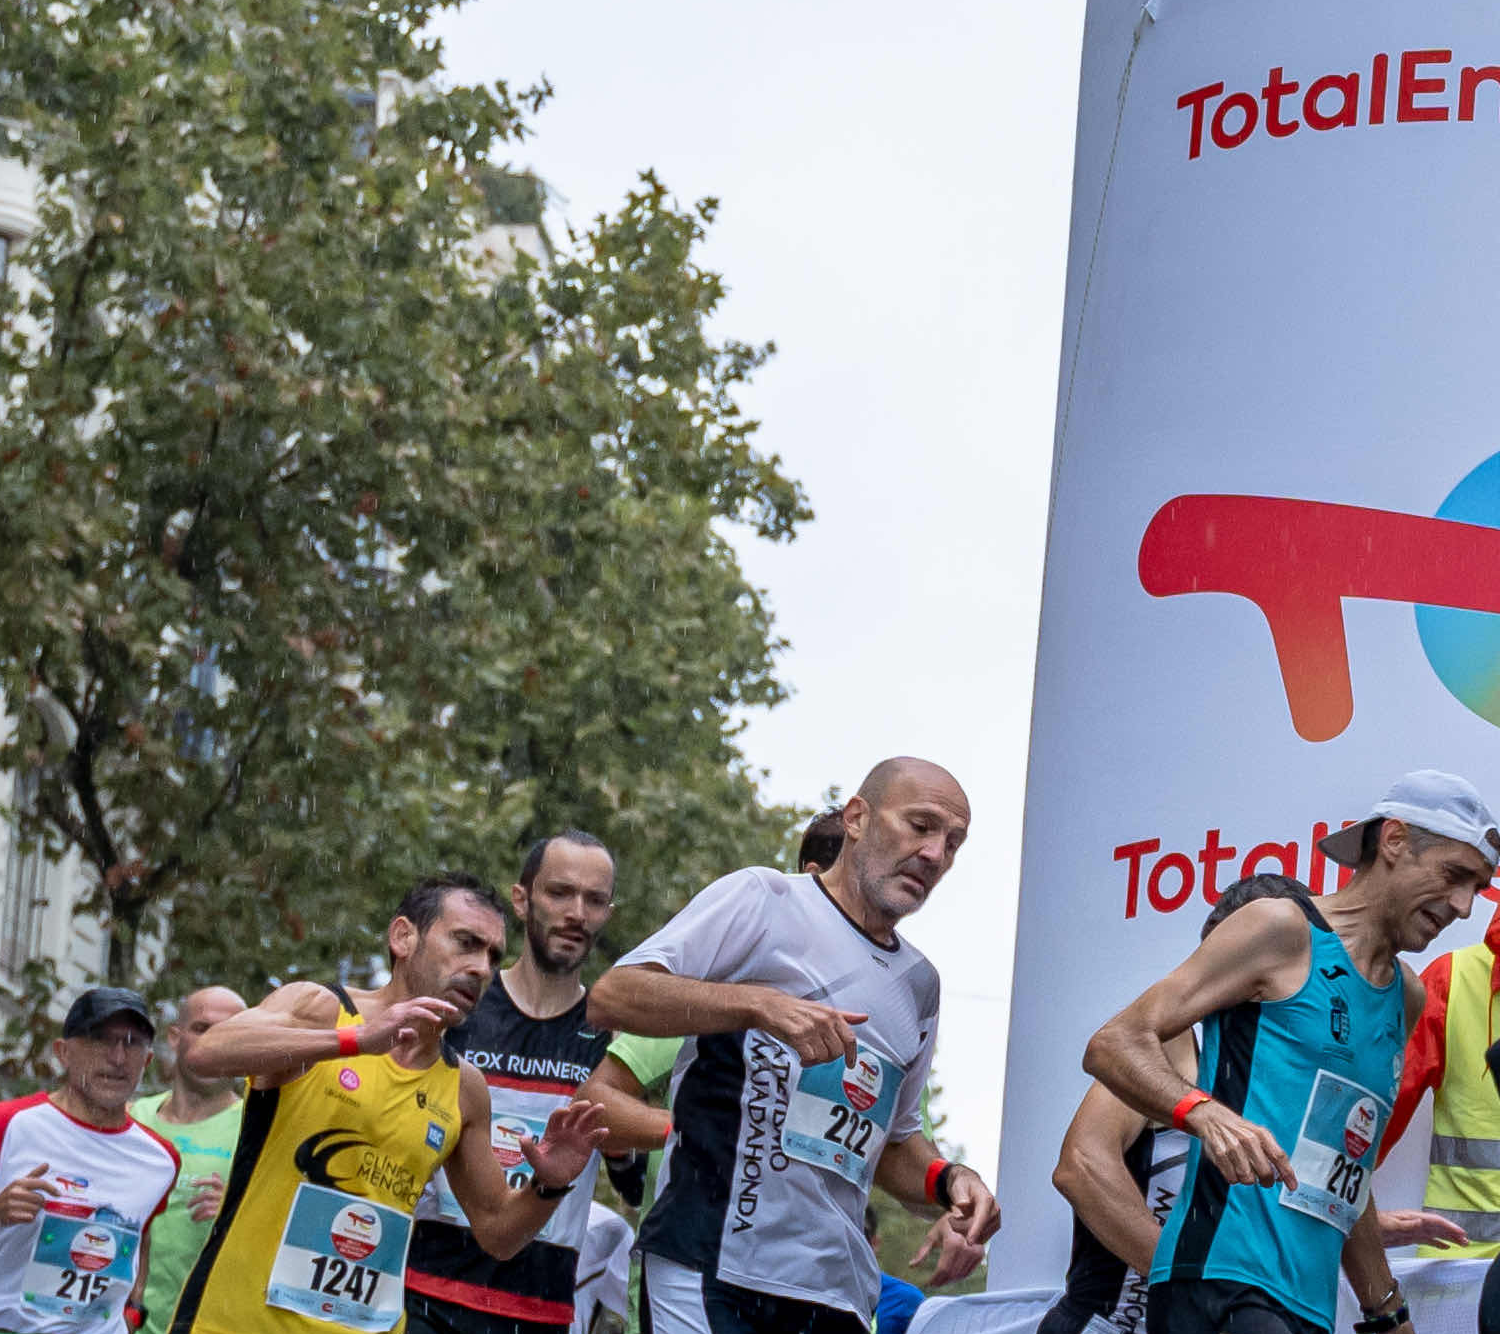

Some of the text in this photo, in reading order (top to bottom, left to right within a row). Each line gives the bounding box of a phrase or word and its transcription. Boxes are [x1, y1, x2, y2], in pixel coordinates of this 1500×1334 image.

[463, 1050, 592, 1083] FOX RUNNERS
[824, 1104, 873, 1159] 222
[1326, 1153, 1364, 1205] 213
[56, 1269, 110, 1304] 215
[309, 1255, 381, 1305] 1247
